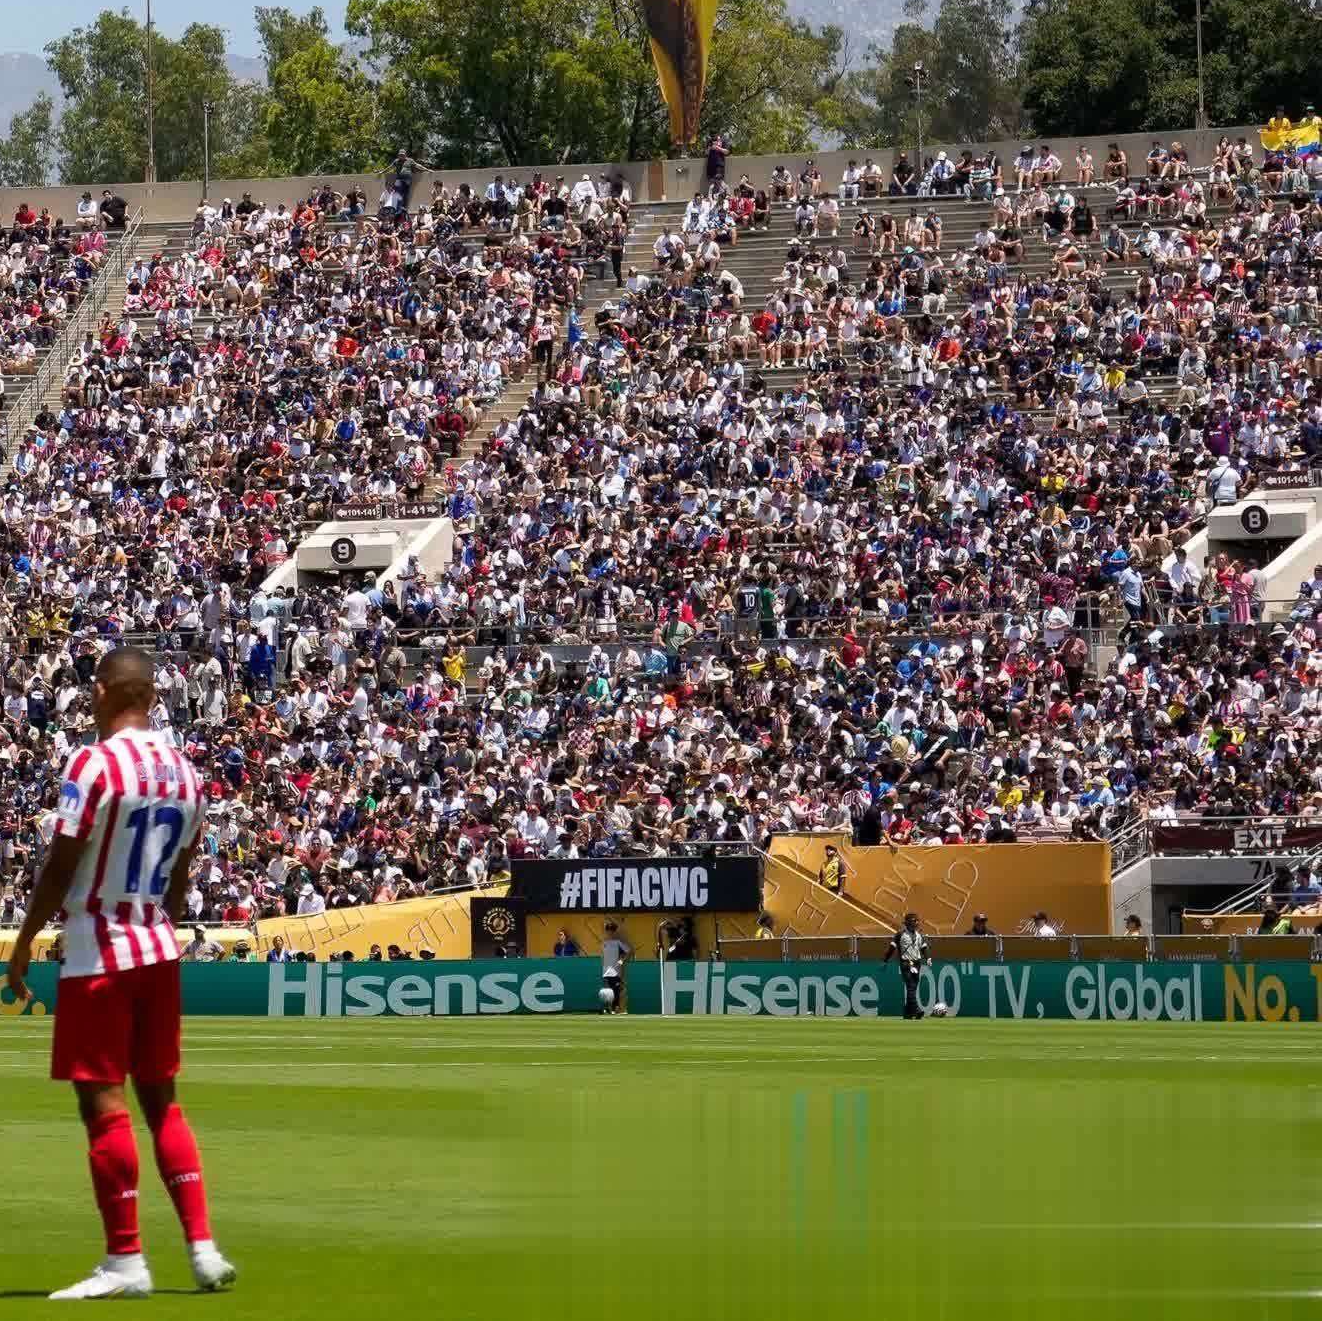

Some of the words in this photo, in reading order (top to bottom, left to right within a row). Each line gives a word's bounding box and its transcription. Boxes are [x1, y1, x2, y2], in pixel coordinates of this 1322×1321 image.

[1276, 475, 1308, 484] 101-141
[347, 508, 376, 517] 101-141
[400, 505, 426, 516] 1-41
[1248, 511, 1261, 528] 8
[337, 542, 350, 559] 9
[744, 594, 755, 607] 10
[1233, 828, 1287, 849] EXIT
[124, 806, 184, 896] 12
[1249, 860, 1274, 880] 7A
[558, 867, 709, 910] #FIFACWC
[267, 961, 565, 1017] Hisense
[662, 961, 880, 1017] Hisense
[899, 962, 974, 1017] 00"
[980, 964, 1045, 1019] TV,
[1064, 964, 1202, 1020] Global
[1224, 964, 1301, 1022] No.
